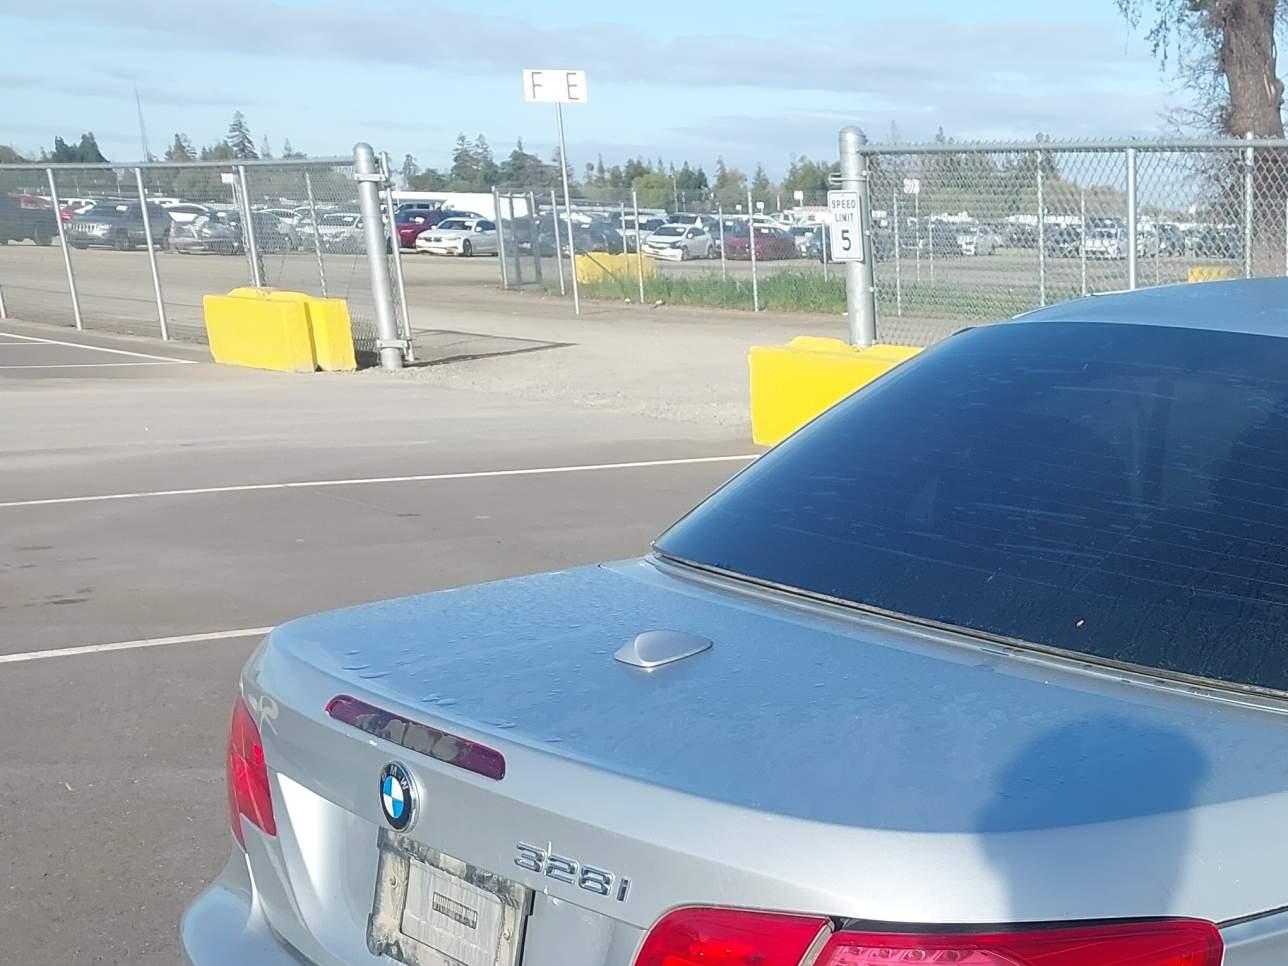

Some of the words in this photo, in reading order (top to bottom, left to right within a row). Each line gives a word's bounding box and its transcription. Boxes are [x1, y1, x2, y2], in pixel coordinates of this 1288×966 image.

[531, 71, 543, 99] F
[566, 71, 580, 100] E
[831, 199, 857, 209] SPEED
[834, 213, 854, 222] LIMIT
[841, 229, 852, 251] 5
